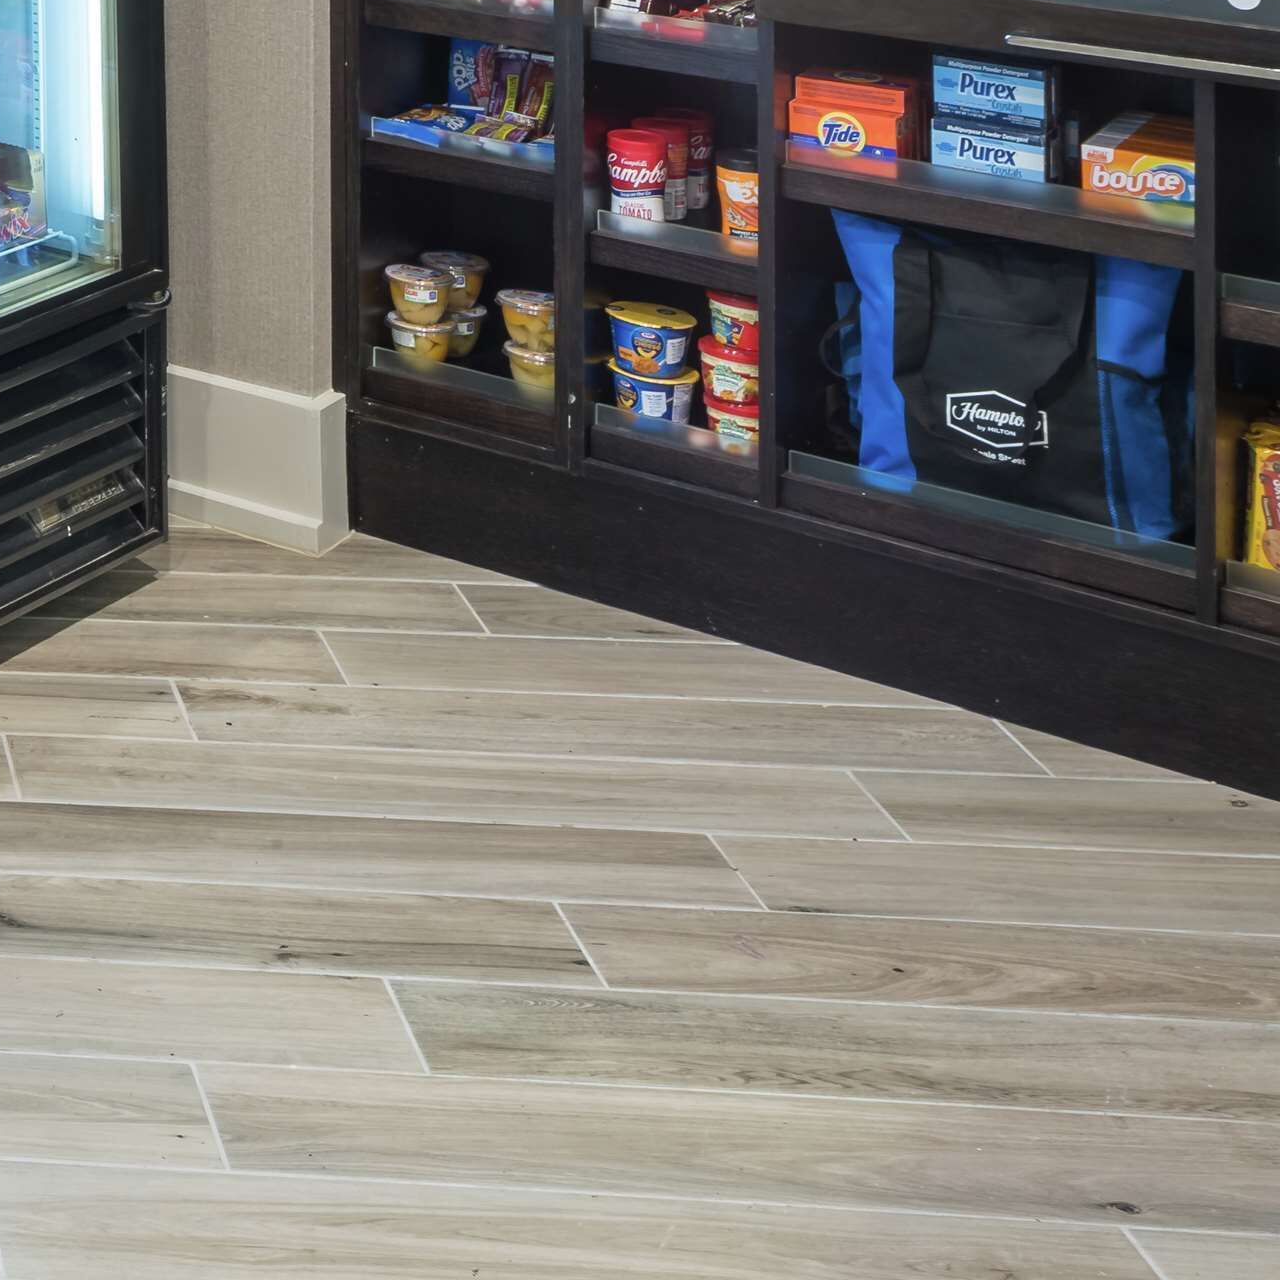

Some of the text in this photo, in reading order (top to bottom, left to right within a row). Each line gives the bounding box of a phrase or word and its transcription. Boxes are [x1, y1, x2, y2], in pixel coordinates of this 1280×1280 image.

[948, 60, 982, 71] Multipurpose
[1002, 67, 1029, 77] Detergent
[958, 72, 1017, 102] Purex
[823, 122, 861, 145] Tide
[958, 135, 1017, 167] Purex
[1092, 165, 1183, 194] bounce
[988, 426, 1016, 437] HILTON
